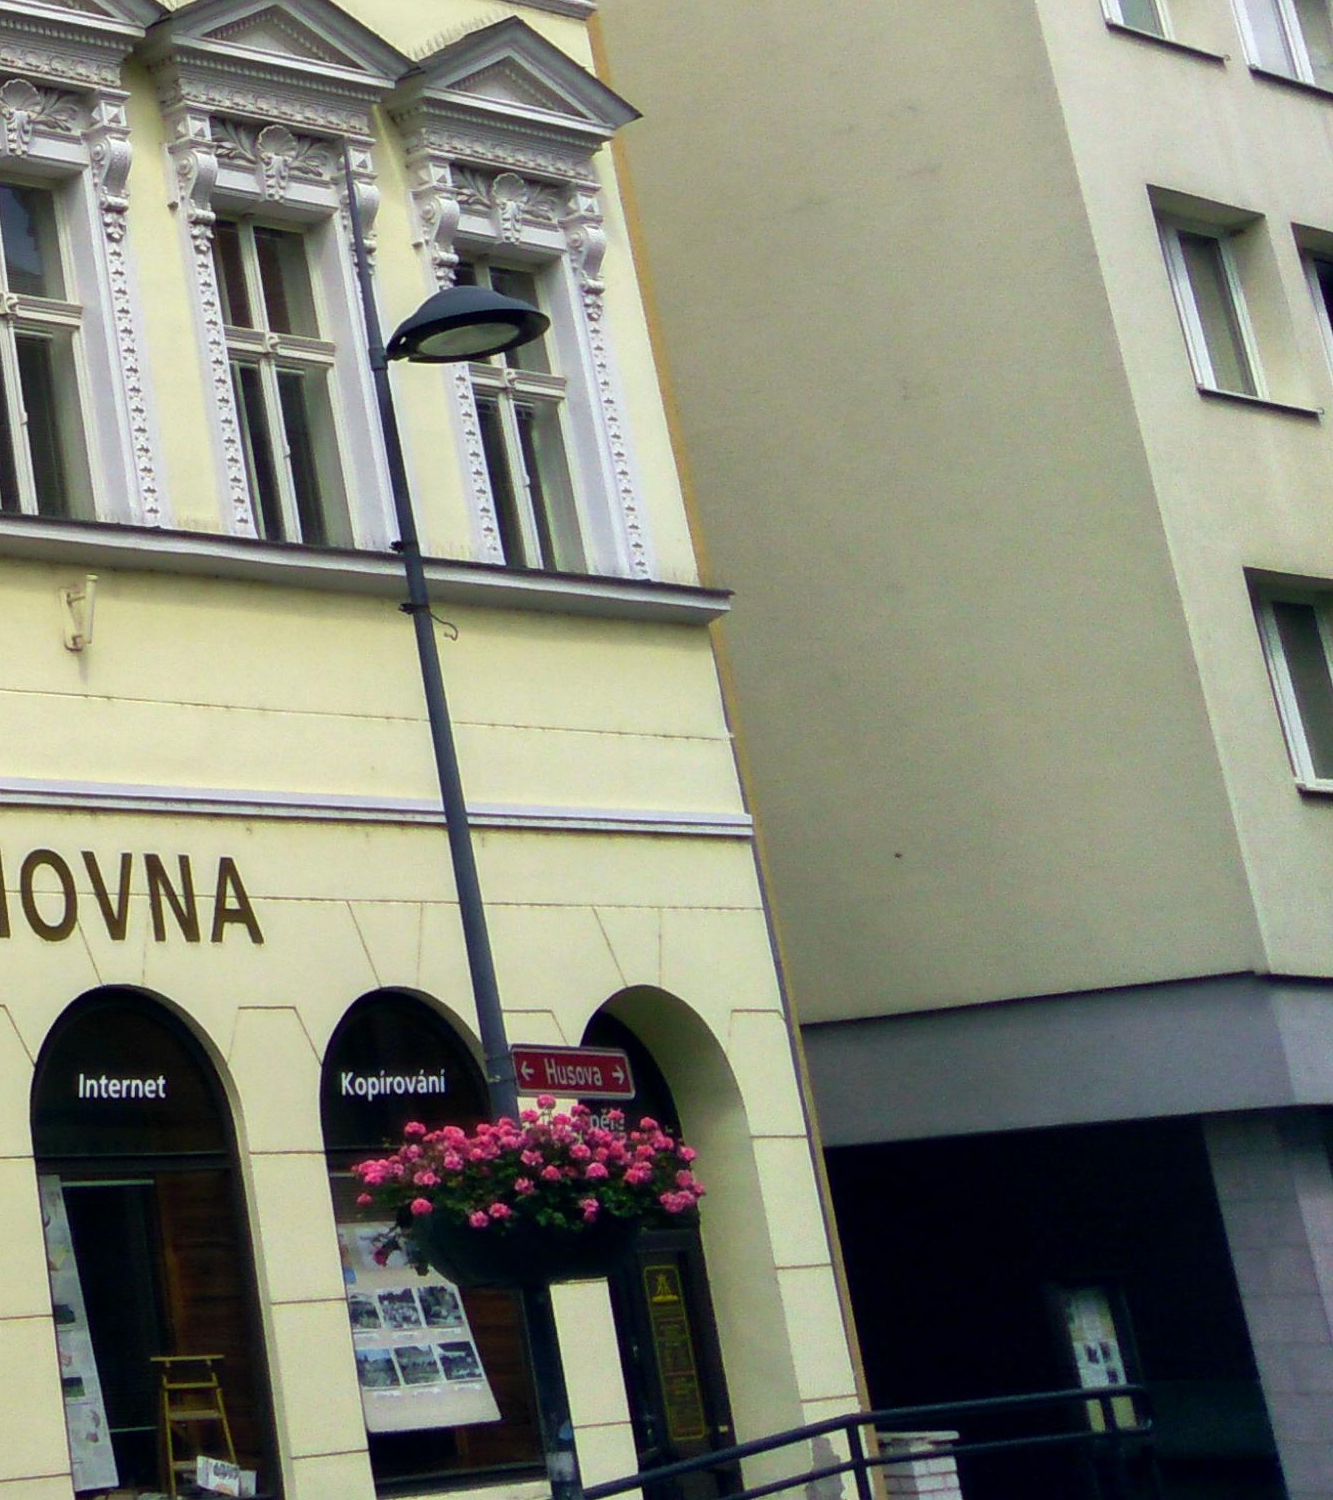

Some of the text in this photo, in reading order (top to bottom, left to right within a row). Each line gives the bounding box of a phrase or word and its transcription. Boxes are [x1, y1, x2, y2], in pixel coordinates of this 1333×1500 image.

[78, 1073, 166, 1099] Internet
[340, 1068, 445, 1102] Kopírování
[544, 1057, 602, 1086] Husova
